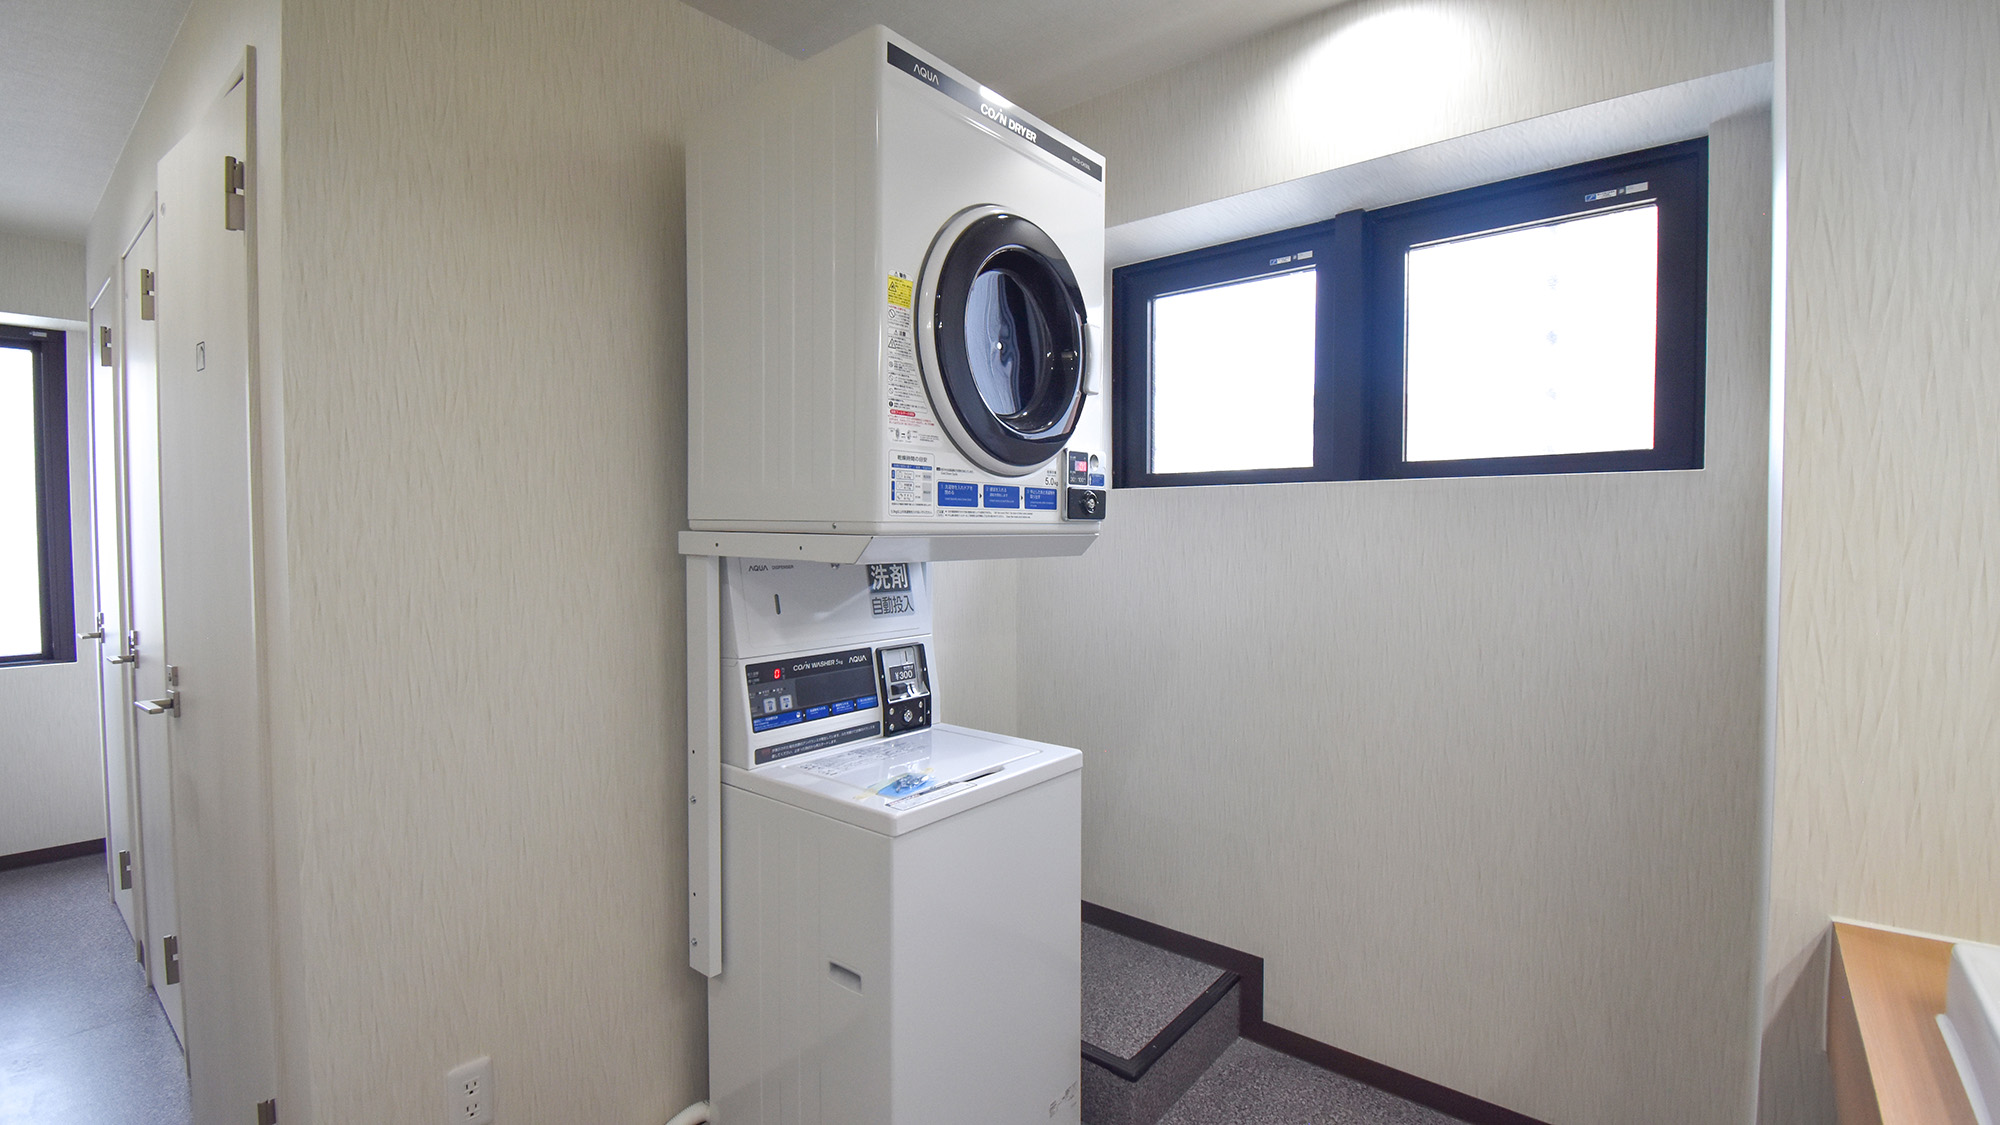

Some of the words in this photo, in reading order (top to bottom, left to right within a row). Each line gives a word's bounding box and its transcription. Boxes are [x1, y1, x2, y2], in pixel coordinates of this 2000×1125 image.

[913, 63, 940, 86] AQUA
[1008, 118, 1037, 143] DRYER
[748, 564, 769, 572] AQUA
[870, 564, 909, 590] 洗剤
[872, 595, 915, 616] 自動投入
[811, 659, 836, 669] WASHER
[848, 654, 868, 664] AQUA
[773, 668, 781, 679] 0
[895, 670, 913, 681] ¥300
